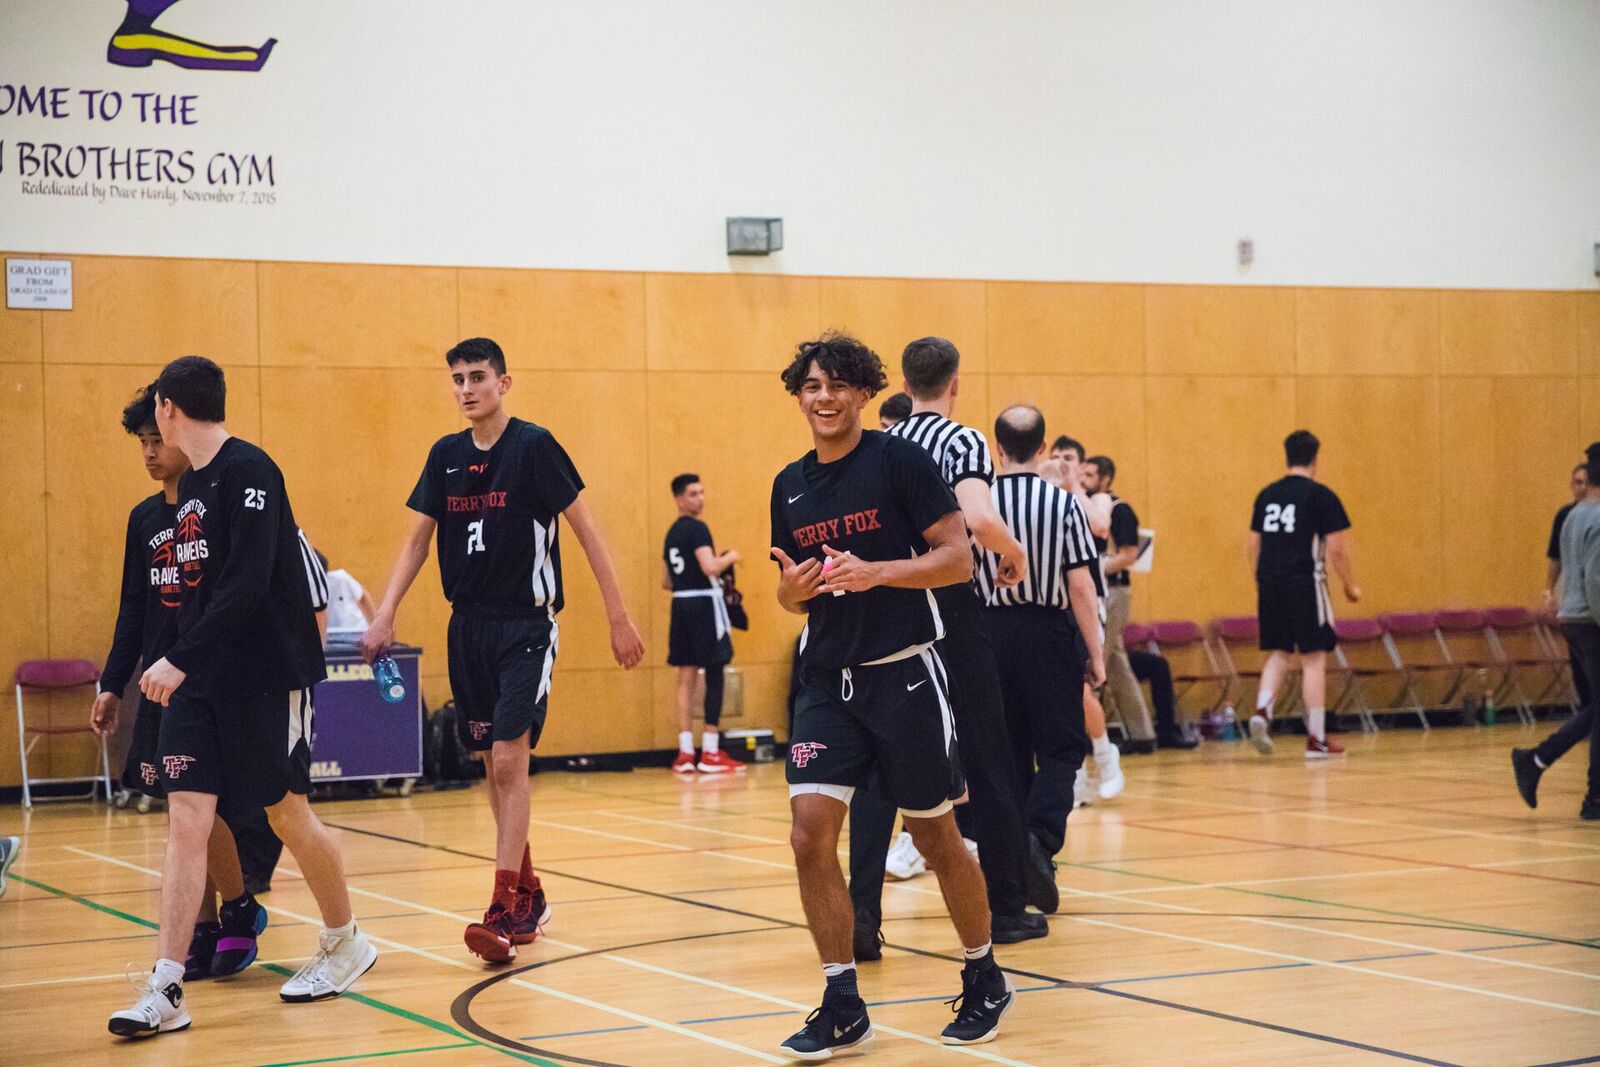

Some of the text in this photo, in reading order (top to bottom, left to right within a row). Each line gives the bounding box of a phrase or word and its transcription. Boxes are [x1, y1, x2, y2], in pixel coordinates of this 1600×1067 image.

[79, 89, 123, 121] TO
[131, 92, 199, 125] THE
[16, 142, 195, 184] BROTHERS
[207, 152, 275, 187] GYM
[21, 180, 88, 197] Rededicated
[92, 182, 106, 203] by
[109, 185, 137, 199] Dave
[141, 186, 178, 206] Hardy,
[182, 187, 236, 203] November
[252, 191, 277, 204] 2015
[10, 265, 67, 276] GRAD GIFT
[26, 277, 53, 286] FROM
[176, 498, 207, 523] TERRY FOX
[244, 487, 266, 511] 25
[486, 491, 507, 508] OX
[843, 508, 881, 535] FOX
[1263, 503, 1296, 533] 24
[148, 528, 175, 550] TERR
[467, 518, 486, 555] 21
[669, 547, 685, 575] 5
[150, 566, 180, 585] RAVE
